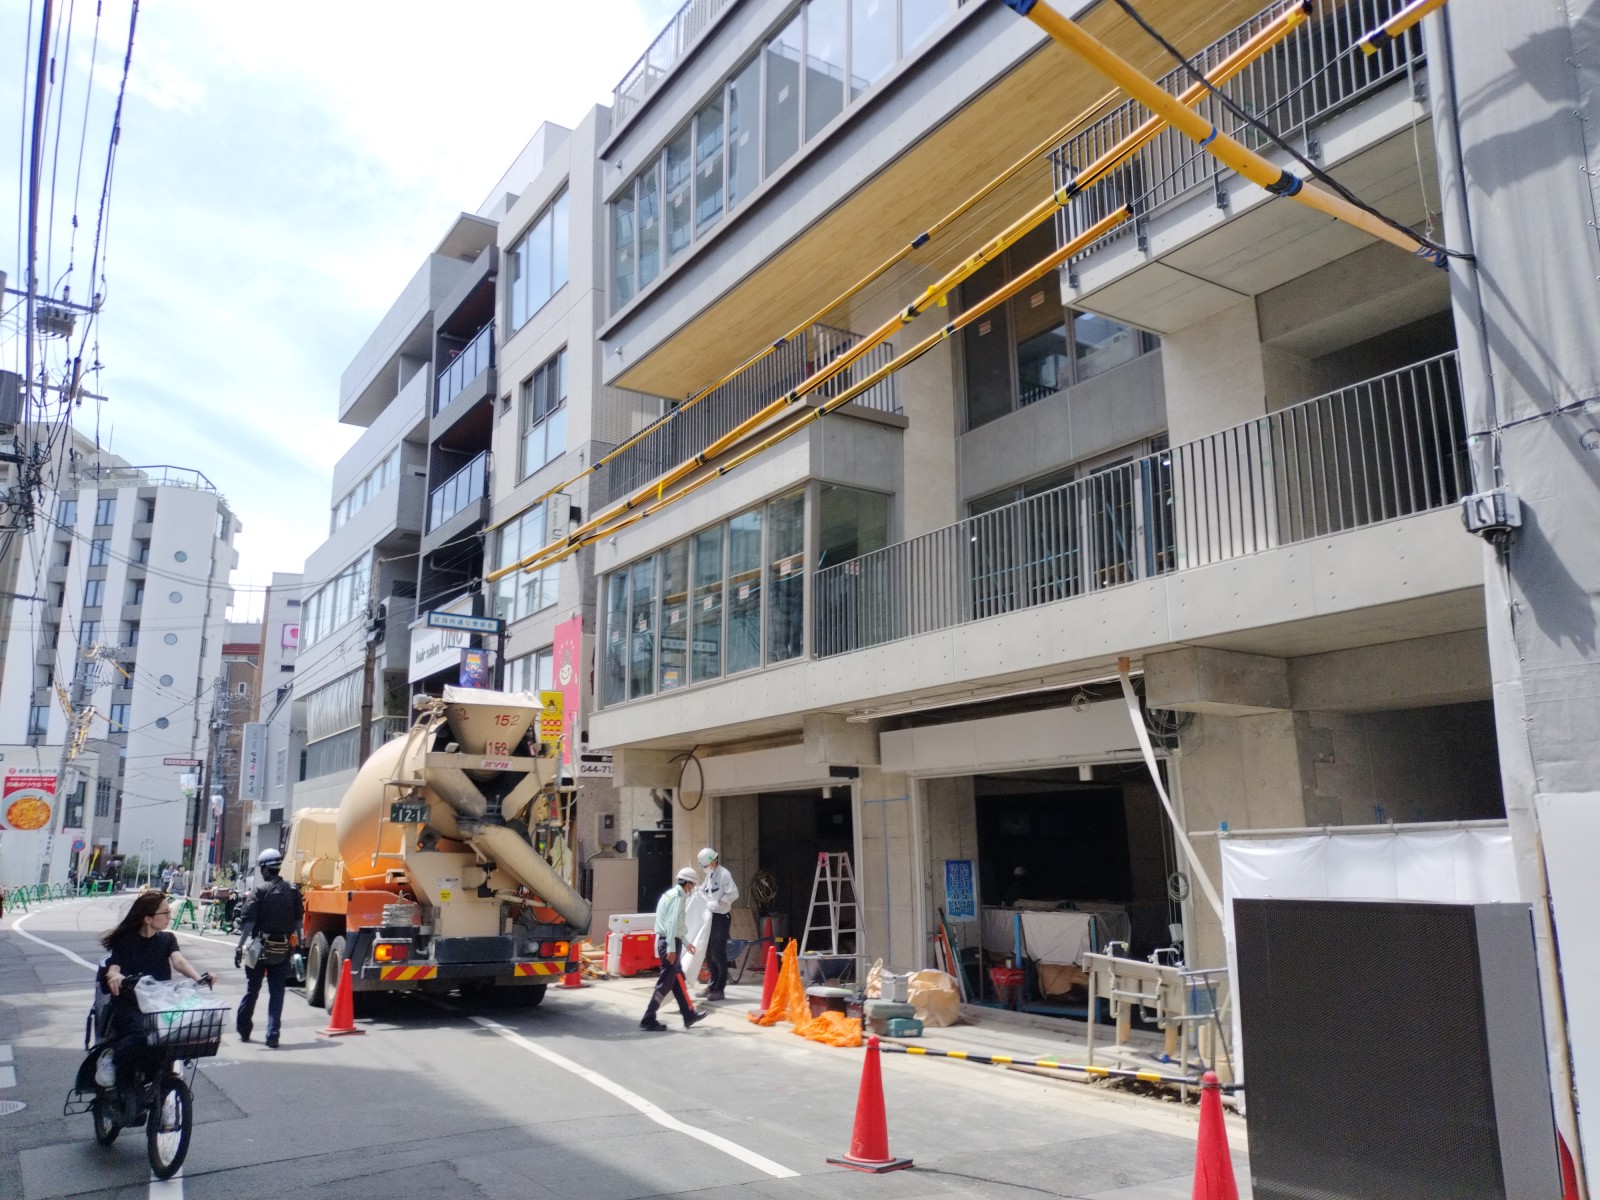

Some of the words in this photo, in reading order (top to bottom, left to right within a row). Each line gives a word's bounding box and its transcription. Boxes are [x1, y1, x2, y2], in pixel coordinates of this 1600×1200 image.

[416, 647, 426, 664] hair
[426, 643, 440, 660] salon
[495, 714, 520, 727] 152
